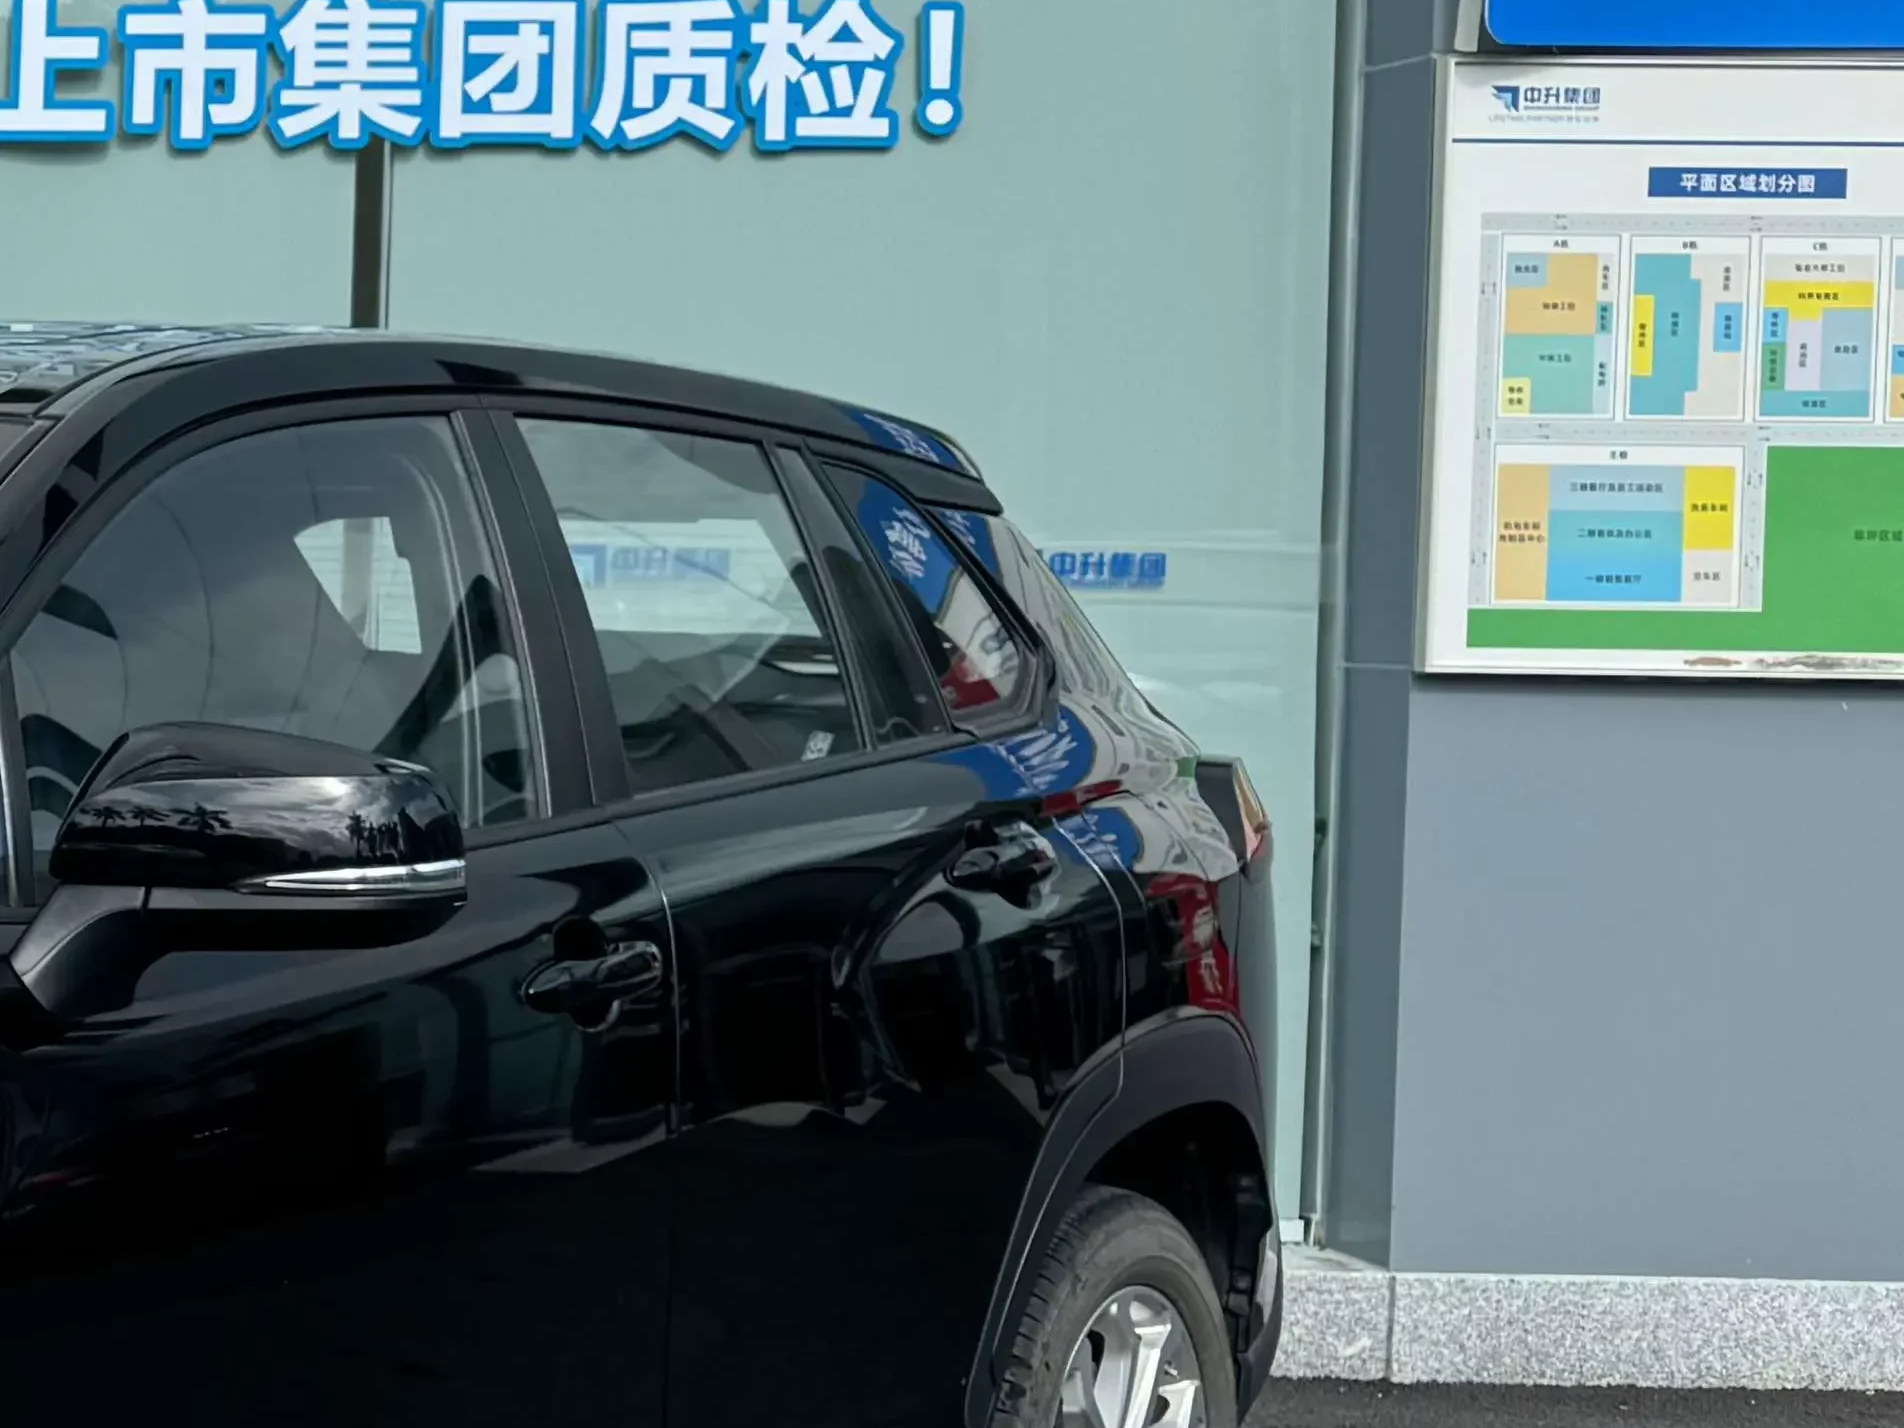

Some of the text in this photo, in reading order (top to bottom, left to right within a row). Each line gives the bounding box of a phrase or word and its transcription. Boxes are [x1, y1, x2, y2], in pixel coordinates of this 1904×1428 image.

[1680, 174, 1815, 193] 平面区域划分图
